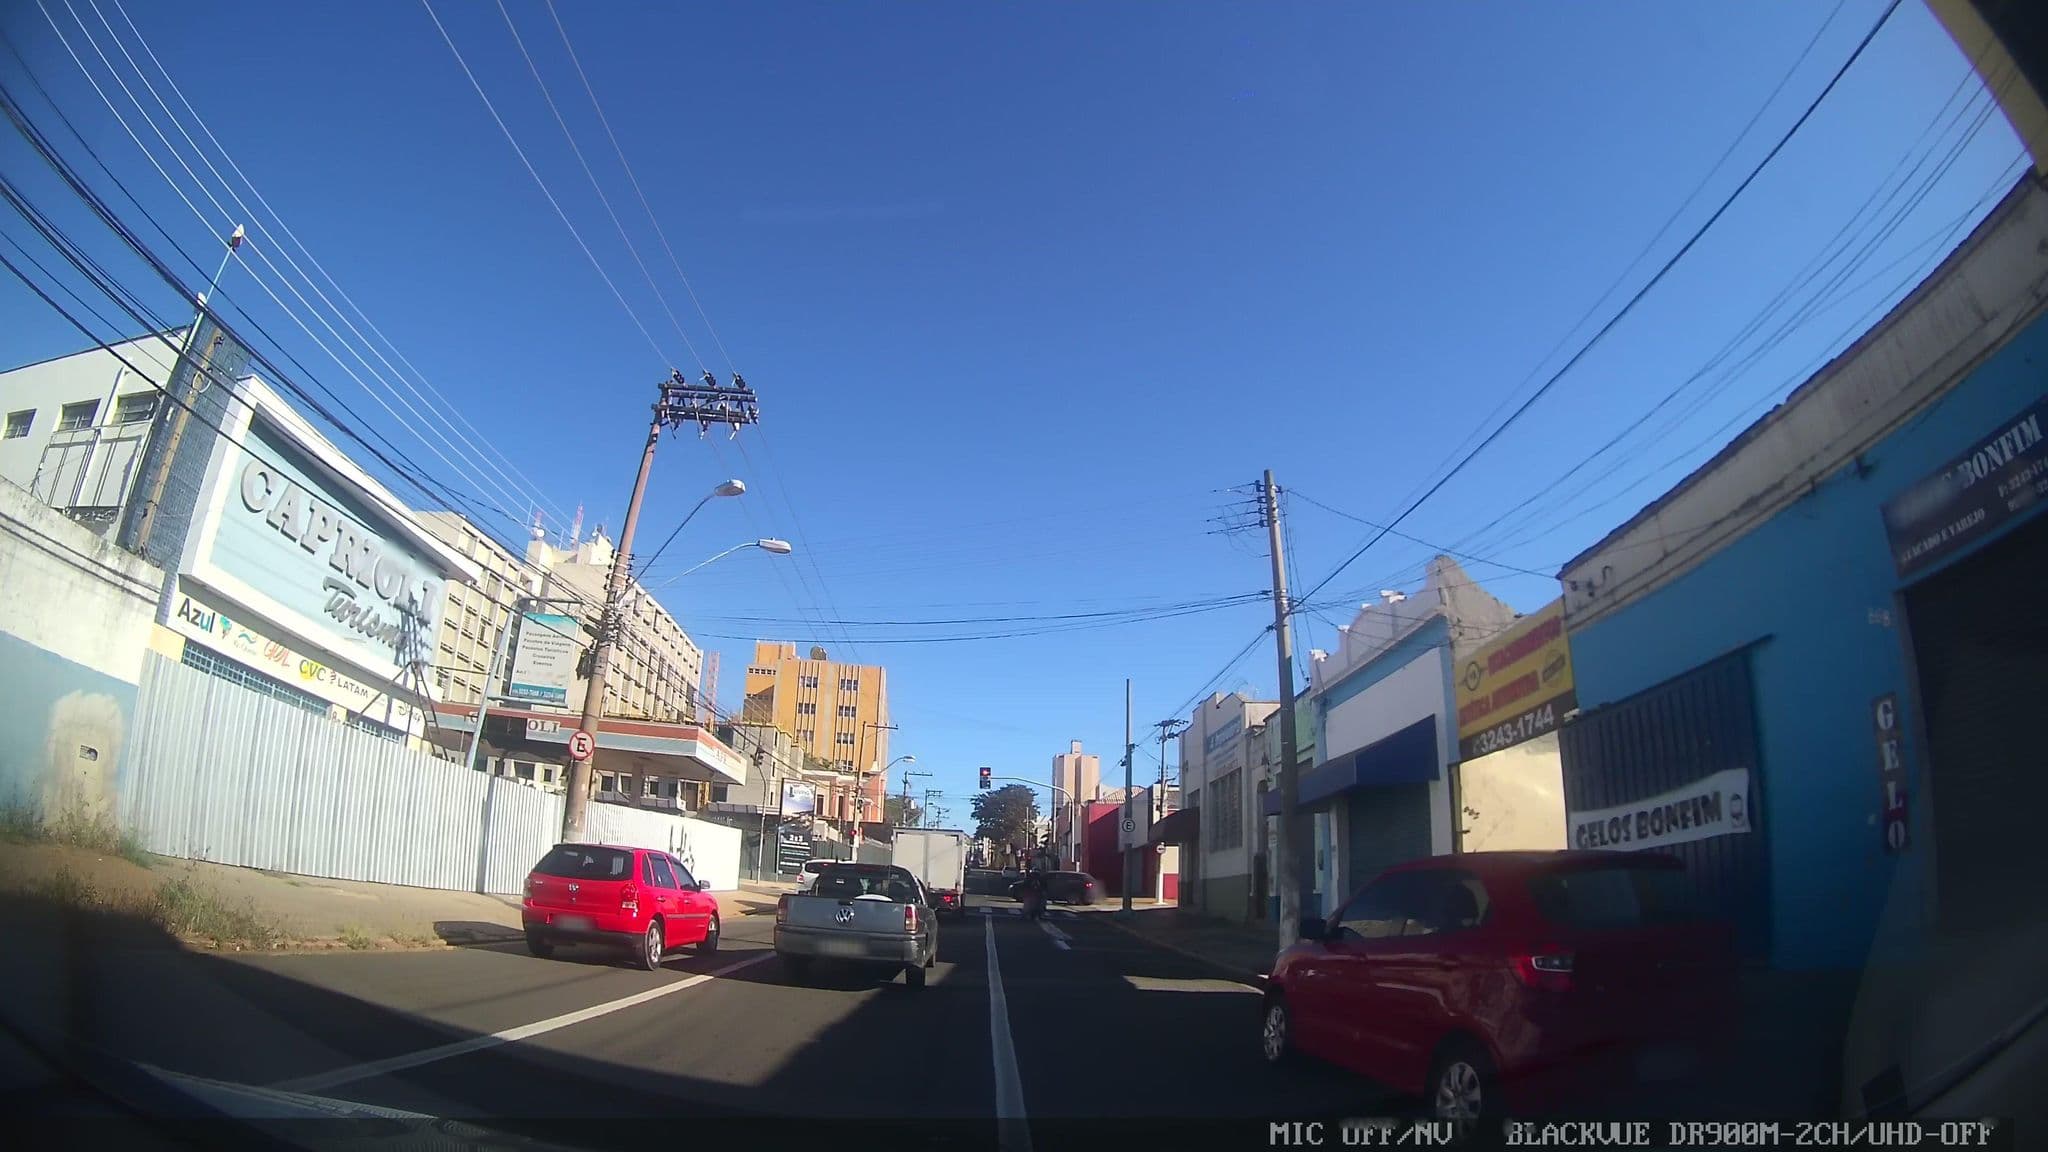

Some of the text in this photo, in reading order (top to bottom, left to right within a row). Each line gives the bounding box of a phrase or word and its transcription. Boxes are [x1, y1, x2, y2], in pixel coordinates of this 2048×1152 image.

[1956, 413, 2043, 489] BONFIM
[176, 598, 215, 634] Azul
[299, 658, 326, 682] CVC
[337, 679, 369, 699] LATAM
[1876, 700, 1906, 850] GELO
[1125, 821, 1132, 830] E
[1575, 790, 1722, 850] GELOS BONFIM
